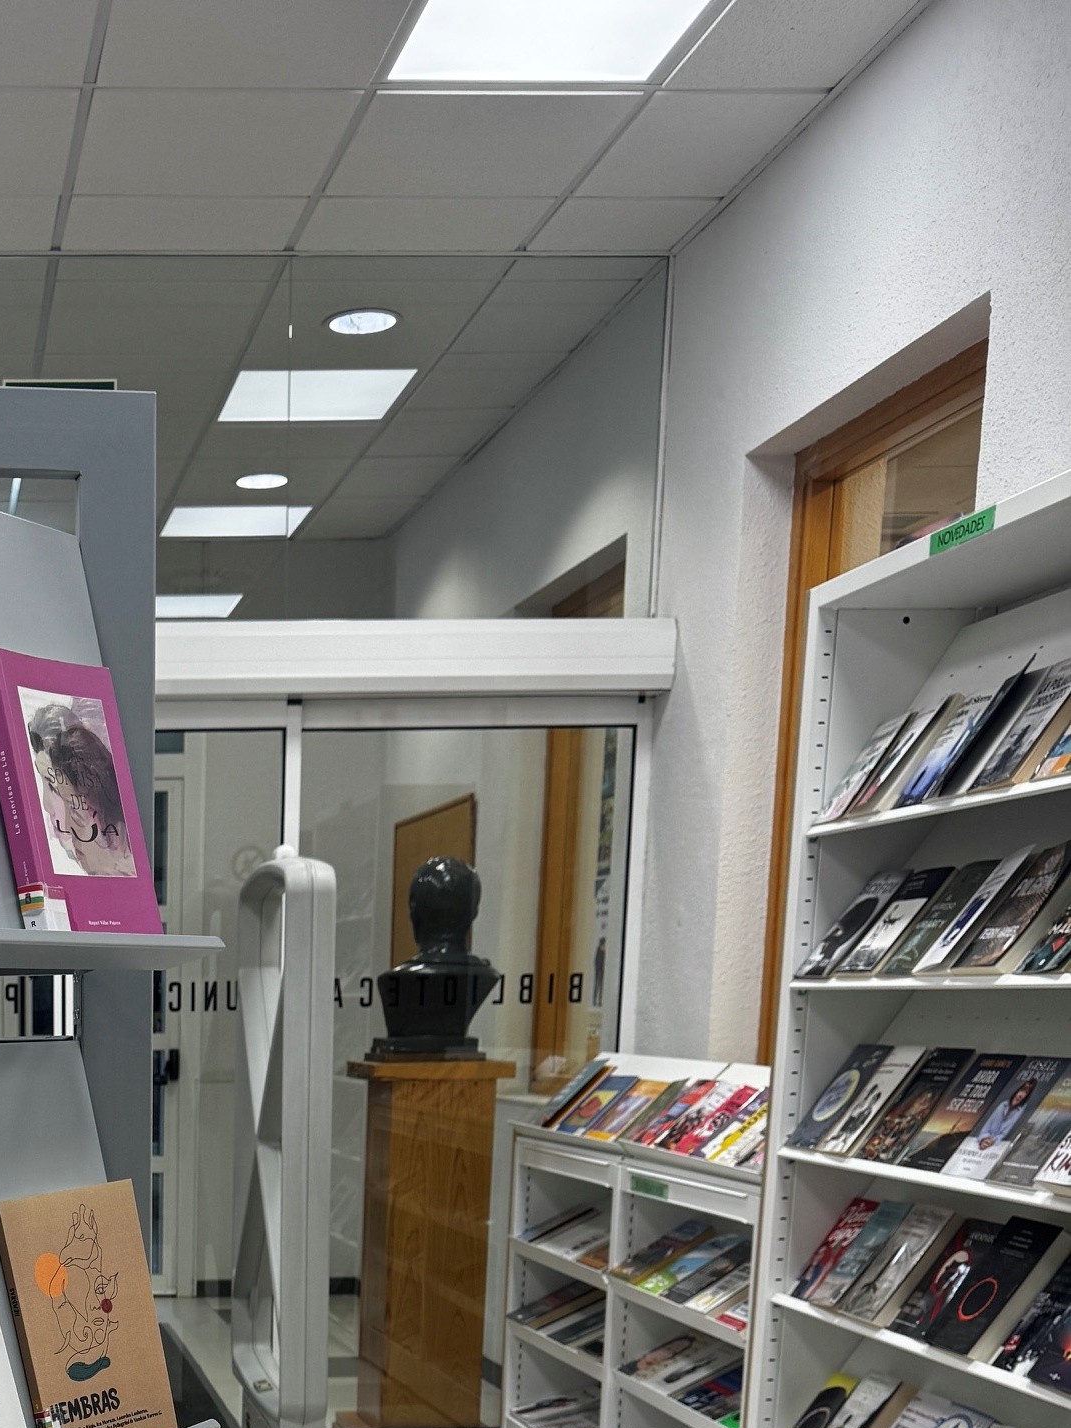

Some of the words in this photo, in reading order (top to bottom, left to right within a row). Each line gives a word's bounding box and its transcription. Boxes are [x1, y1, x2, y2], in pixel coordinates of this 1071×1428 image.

[937, 515, 986, 548] NOVEDADES
[4, 772, 11, 783] de
[7, 786, 18, 821] sonrisa
[70, 794, 90, 811] DE
[56, 811, 119, 843] LÚA
[50, 1387, 121, 1425] HEMBRAS
